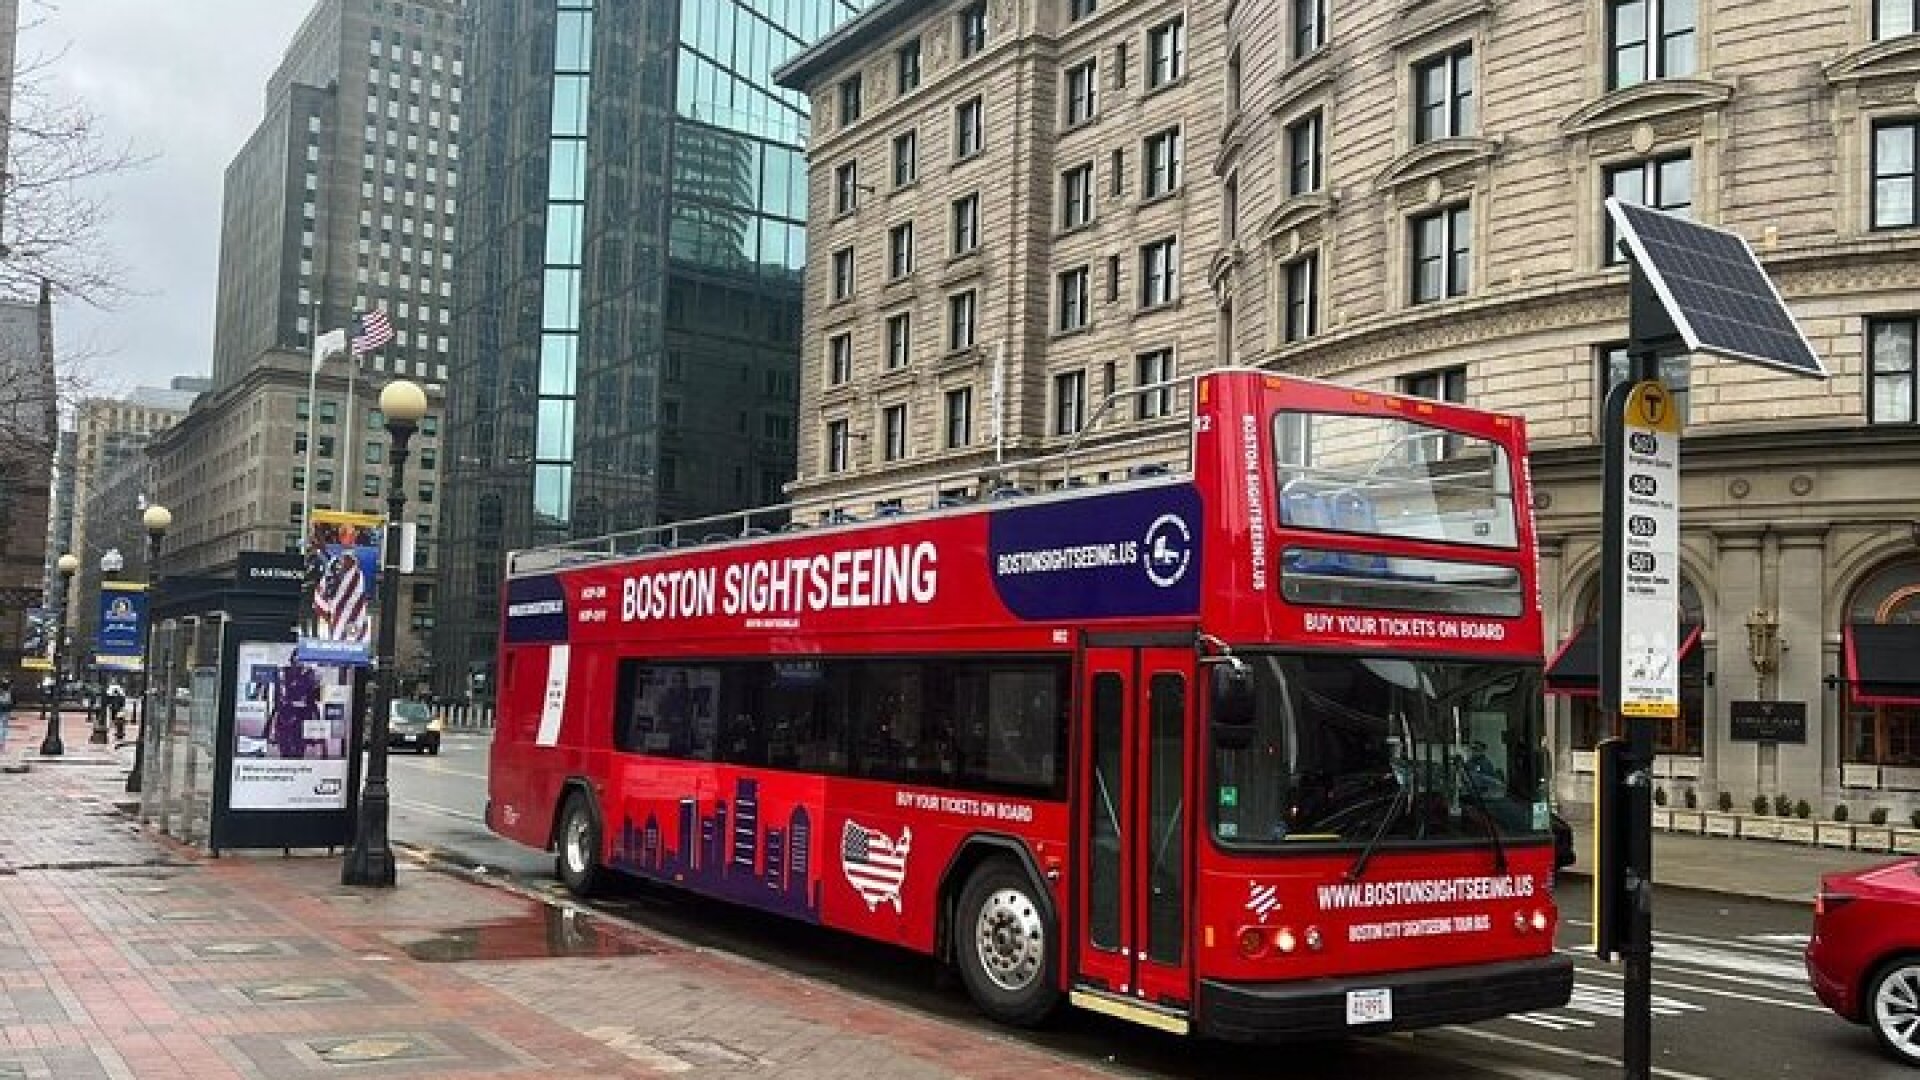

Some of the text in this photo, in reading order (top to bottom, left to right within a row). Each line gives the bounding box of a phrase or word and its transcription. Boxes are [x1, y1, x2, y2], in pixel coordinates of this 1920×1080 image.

[1645, 395, 1661, 416] T
[1243, 415, 1260, 470] BOSTON
[997, 541, 1136, 576] BOSTONSIGHTSEEING.US
[622, 541, 937, 621] BOSTON SIGHTSEEING
[1304, 613, 1504, 640] BUY YOUR TICKETS ON BOARD
[896, 791, 1032, 821] BUY YOUR TICKETS ON BOARD
[1318, 875, 1534, 909] WWW.BOSTONSIGHTSEEING.US
